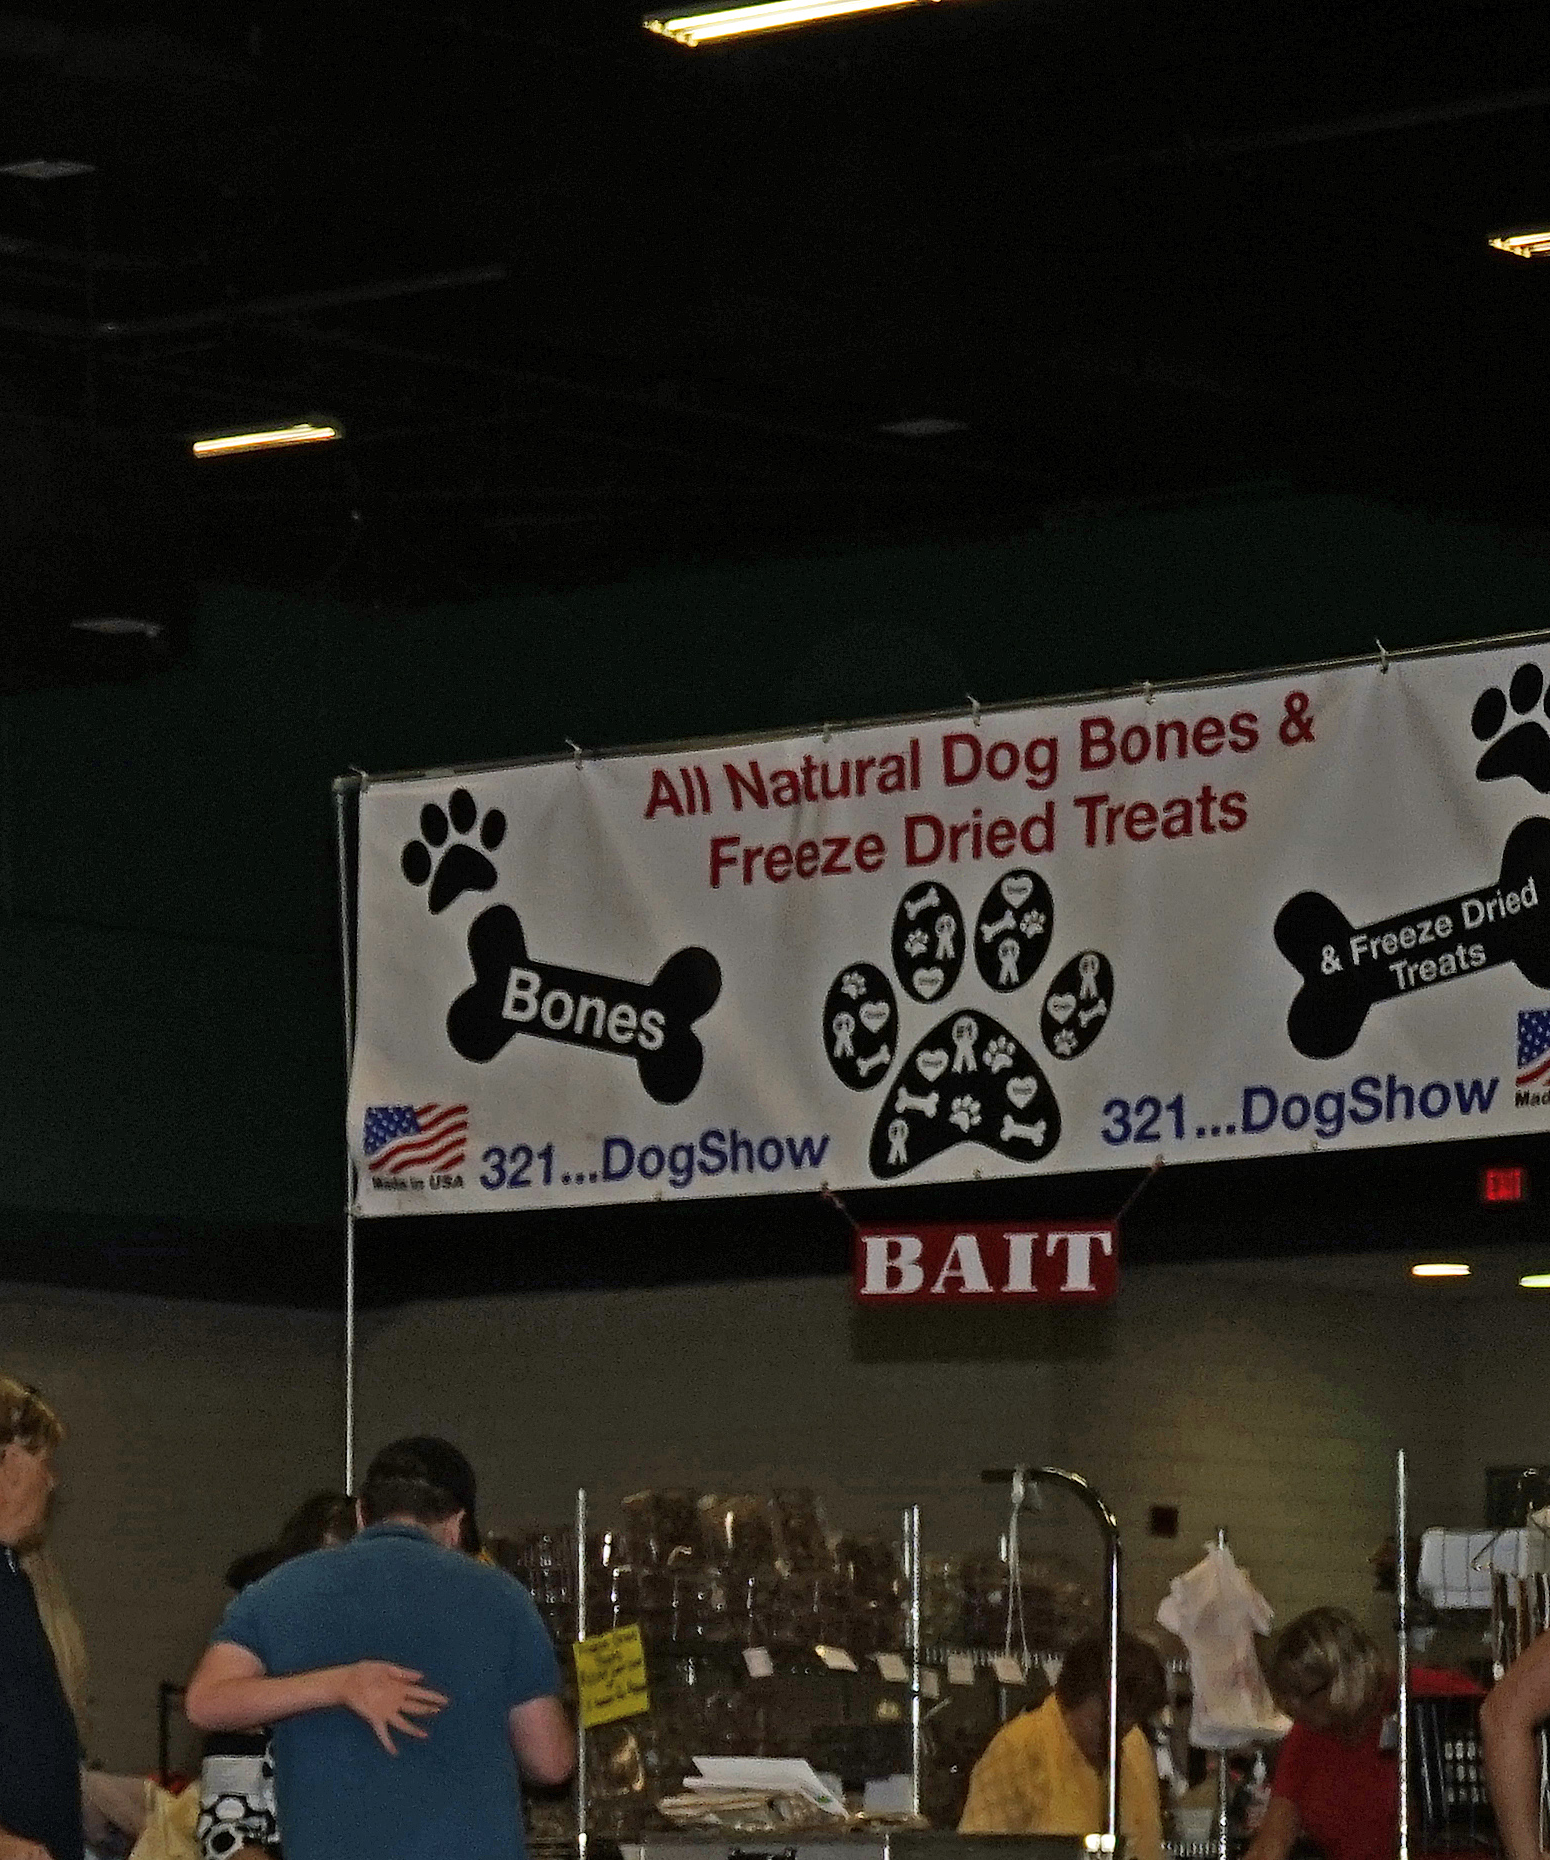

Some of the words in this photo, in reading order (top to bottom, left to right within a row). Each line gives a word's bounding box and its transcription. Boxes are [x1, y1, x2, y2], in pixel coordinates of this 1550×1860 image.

[644, 765, 712, 820] All
[723, 737, 921, 811] Natural
[943, 732, 1058, 790] Dog
[1080, 711, 1259, 771] Bones
[1279, 690, 1316, 747] &
[710, 833, 886, 888] Freeze
[905, 800, 1055, 868] Dried
[1073, 784, 1247, 848] Treats
[1320, 944, 1344, 975] &
[1350, 914, 1454, 966] Freeze
[1461, 876, 1539, 931] Dried
[1389, 943, 1487, 991] Treats
[502, 966, 666, 1051] Bones
[1101, 1073, 1500, 1146] 321...DogShow
[429, 1174, 464, 1191] USA
[479, 1128, 831, 1191] 321...DogShow
[860, 1231, 1113, 1294] BAIT
